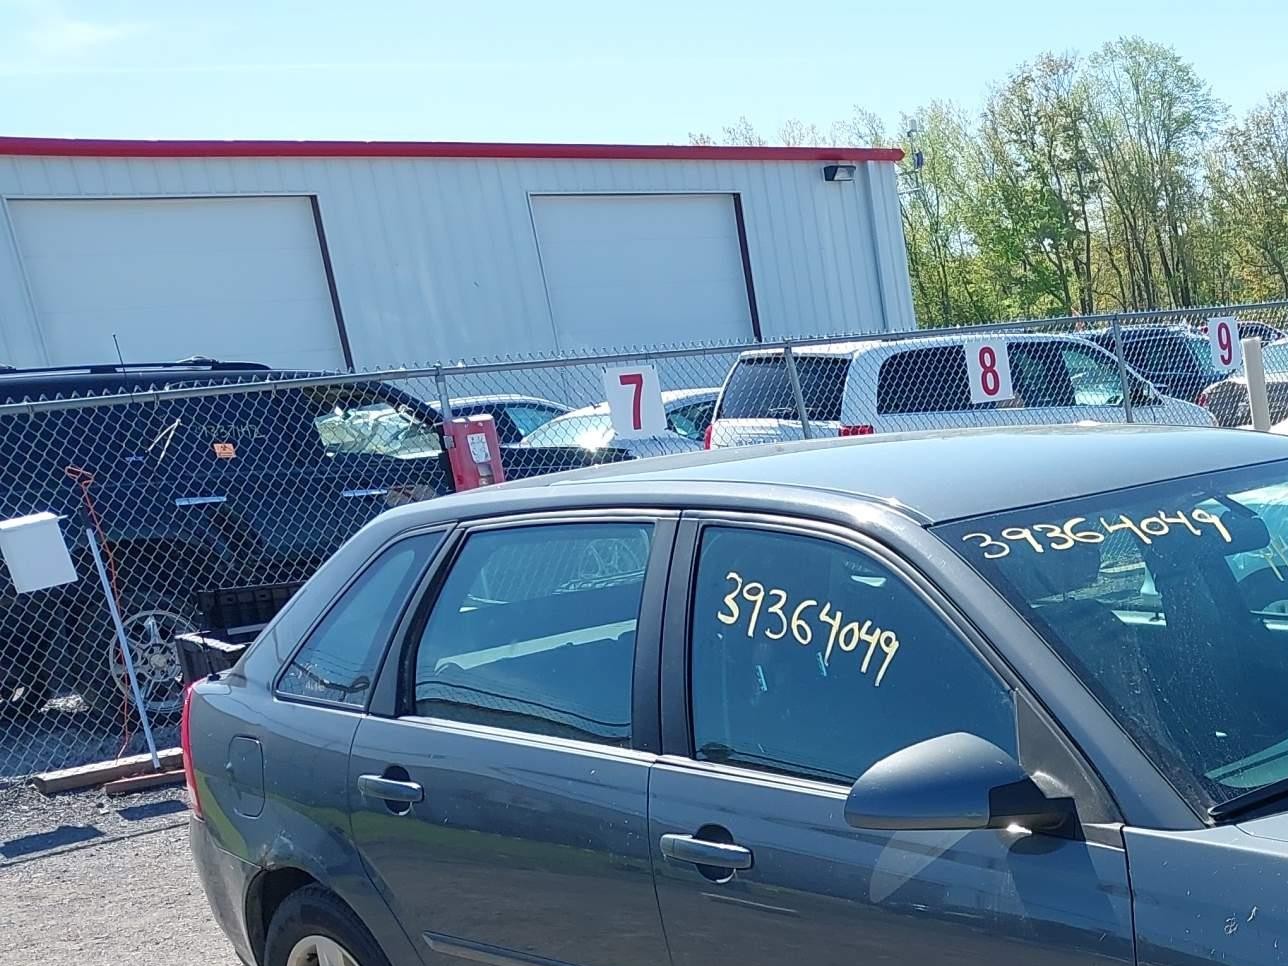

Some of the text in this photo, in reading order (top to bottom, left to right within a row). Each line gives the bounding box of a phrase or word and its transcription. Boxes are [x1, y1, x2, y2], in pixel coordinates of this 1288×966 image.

[1217, 321, 1233, 366] 9
[978, 346, 1000, 396] 8
[618, 373, 644, 431] 7
[962, 508, 1232, 559] 39364049
[717, 571, 900, 687] 39364049
